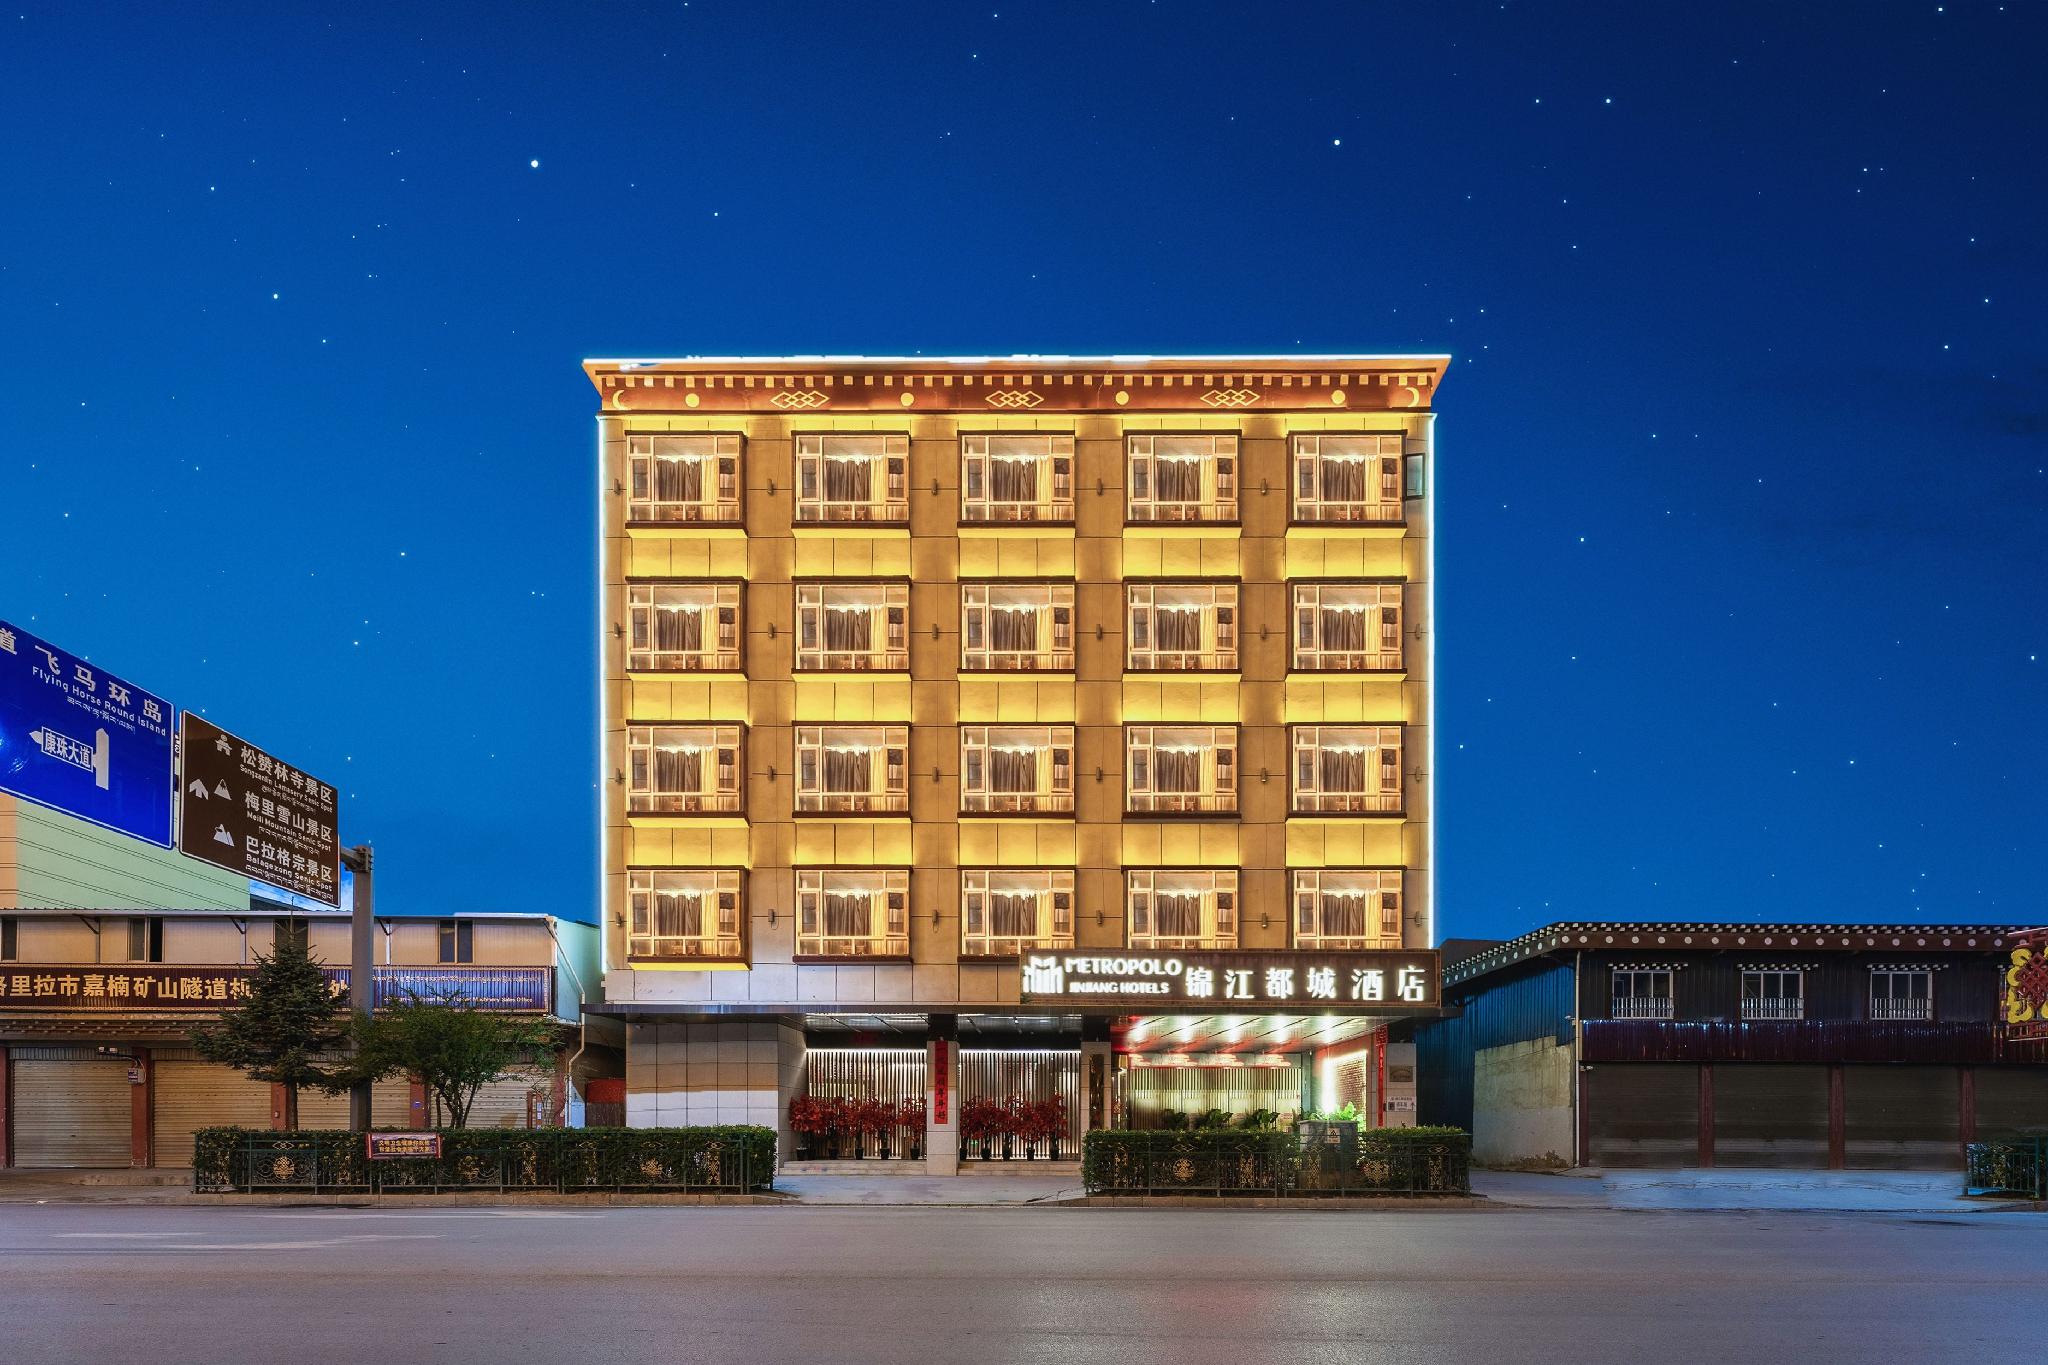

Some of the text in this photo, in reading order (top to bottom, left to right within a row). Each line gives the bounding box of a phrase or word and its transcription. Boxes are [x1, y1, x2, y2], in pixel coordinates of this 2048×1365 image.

[32, 666, 69, 693] Flying
[72, 685, 102, 706] Horse
[104, 700, 135, 722] Round
[138, 716, 166, 737] Island
[34, 645, 162, 724] 飞马环岛
[45, 732, 91, 768] 康珠大道
[241, 745, 333, 805] 松赞林寺景区
[245, 790, 333, 843] 梅里雪山景区
[265, 818, 297, 838] Mountain
[317, 841, 331, 852] Spot
[246, 835, 333, 883] 巴拉格宗景区
[246, 854, 333, 892] Balagezong Senic Spot
[1065, 957, 1183, 976] METROPOLO
[1185, 965, 1427, 1002] 锦江都城酒店
[1120, 981, 1170, 994] HOTELS
